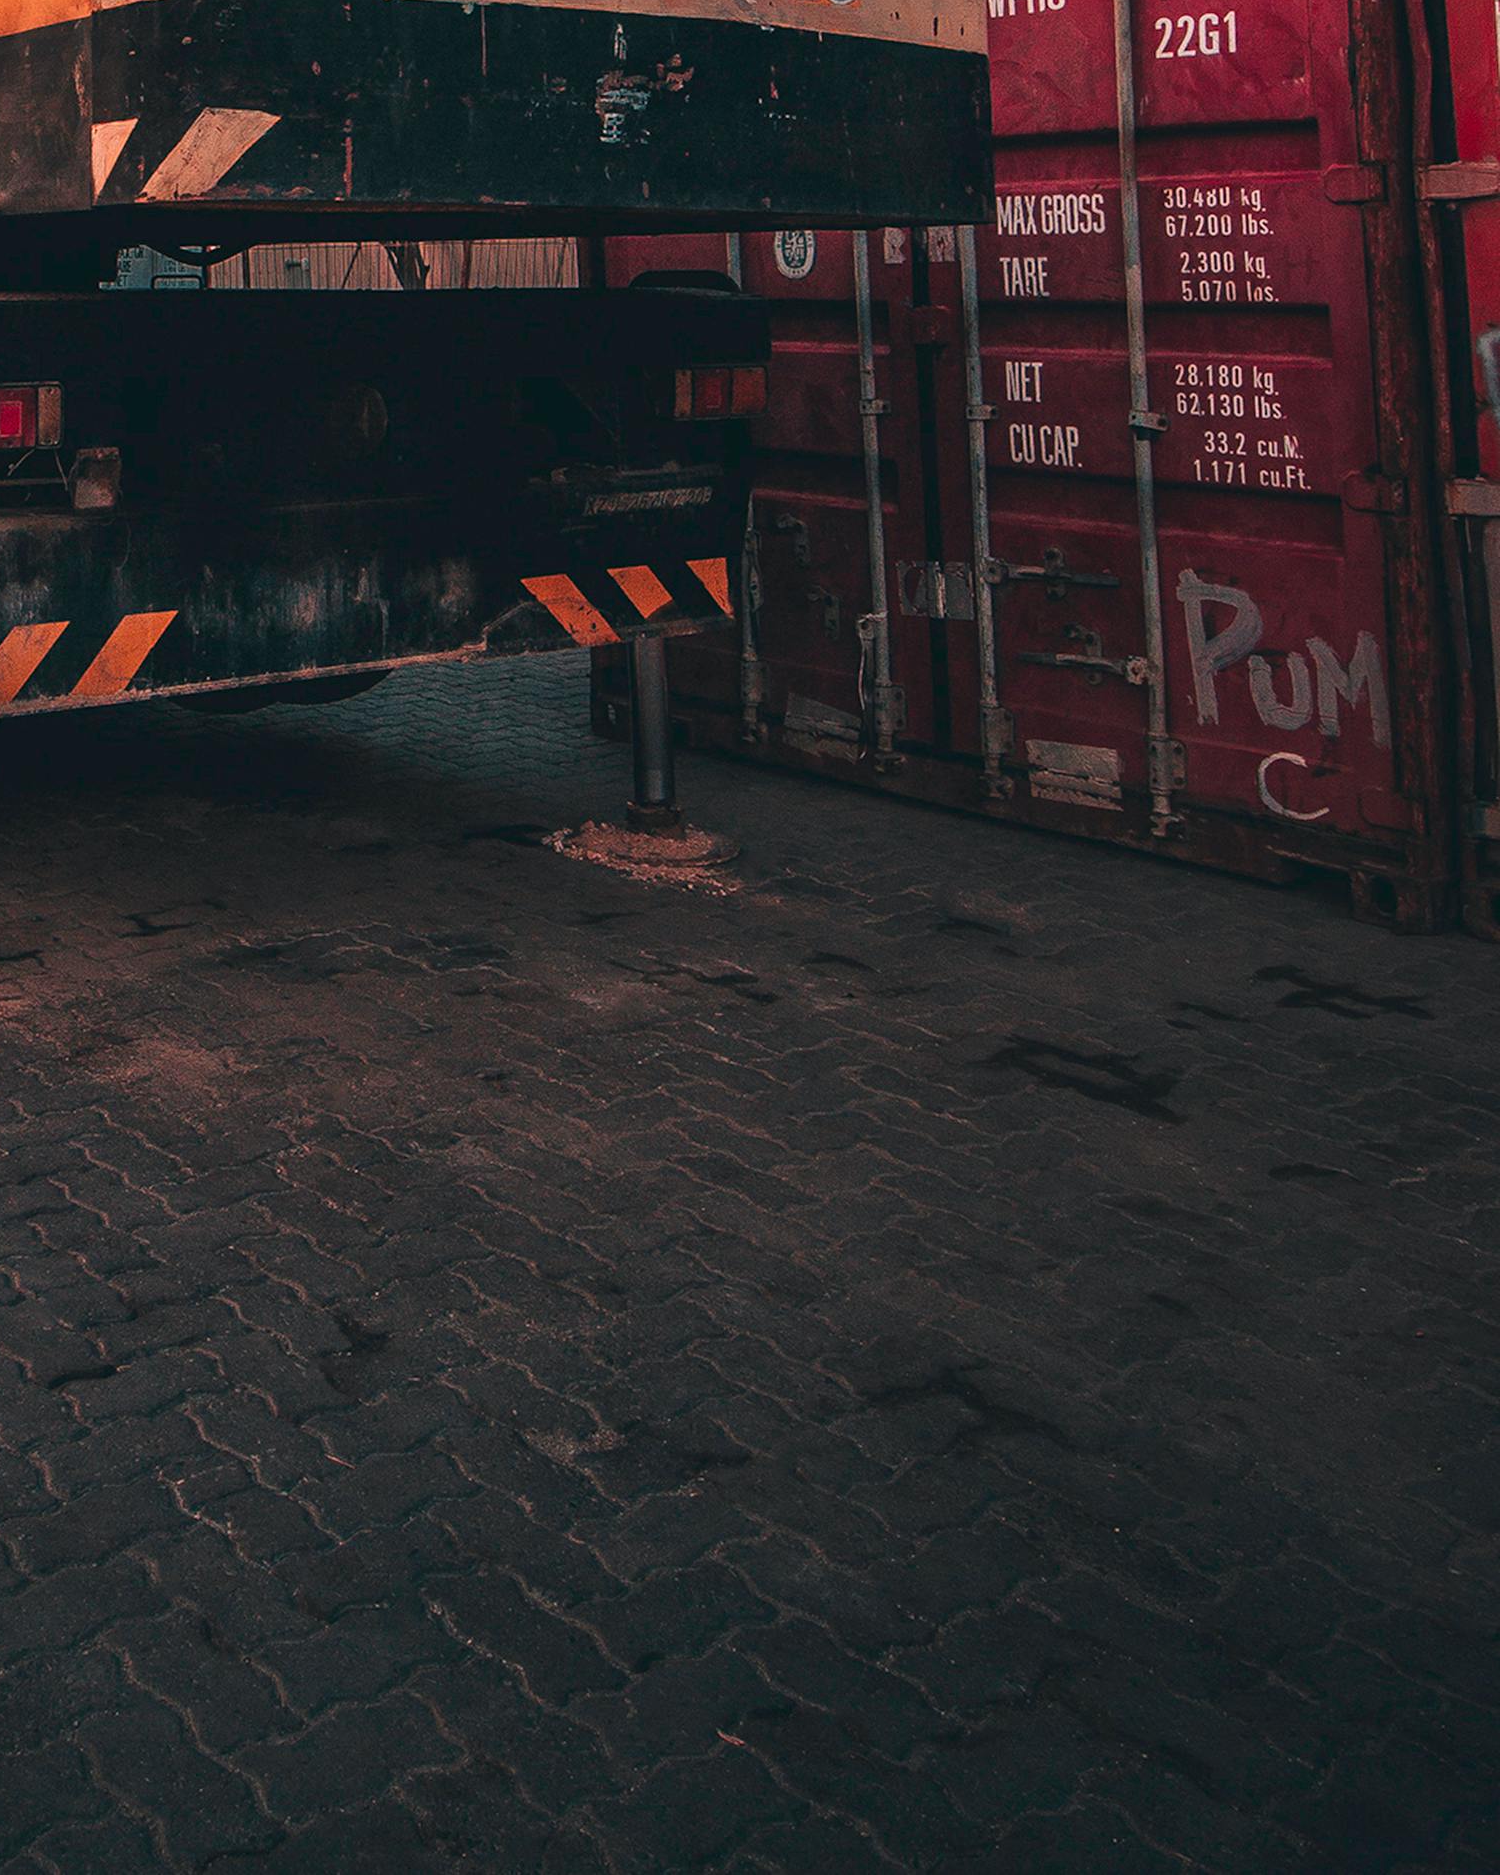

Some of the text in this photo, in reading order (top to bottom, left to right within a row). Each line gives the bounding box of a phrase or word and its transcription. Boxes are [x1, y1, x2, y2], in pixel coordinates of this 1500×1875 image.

[1154, 10, 1238, 59] 22G1
[996, 193, 1106, 235] MAX GROSS
[1240, 187, 1267, 212] kg.
[1165, 213, 1275, 237] 67.200 lbs.
[999, 256, 1051, 298] TARE
[1180, 250, 1271, 280] 2.300 kg.
[1181, 280, 1237, 302] 5.070
[1005, 361, 1044, 403] NET
[1174, 363, 1280, 396] 28.180 kg.
[1176, 392, 1288, 420] 62.130 lbs.
[1009, 423, 1083, 467] CU CAP.
[1204, 430, 1247, 456] 33.2
[1193, 458, 1312, 490] 1.171 cu.Ft.
